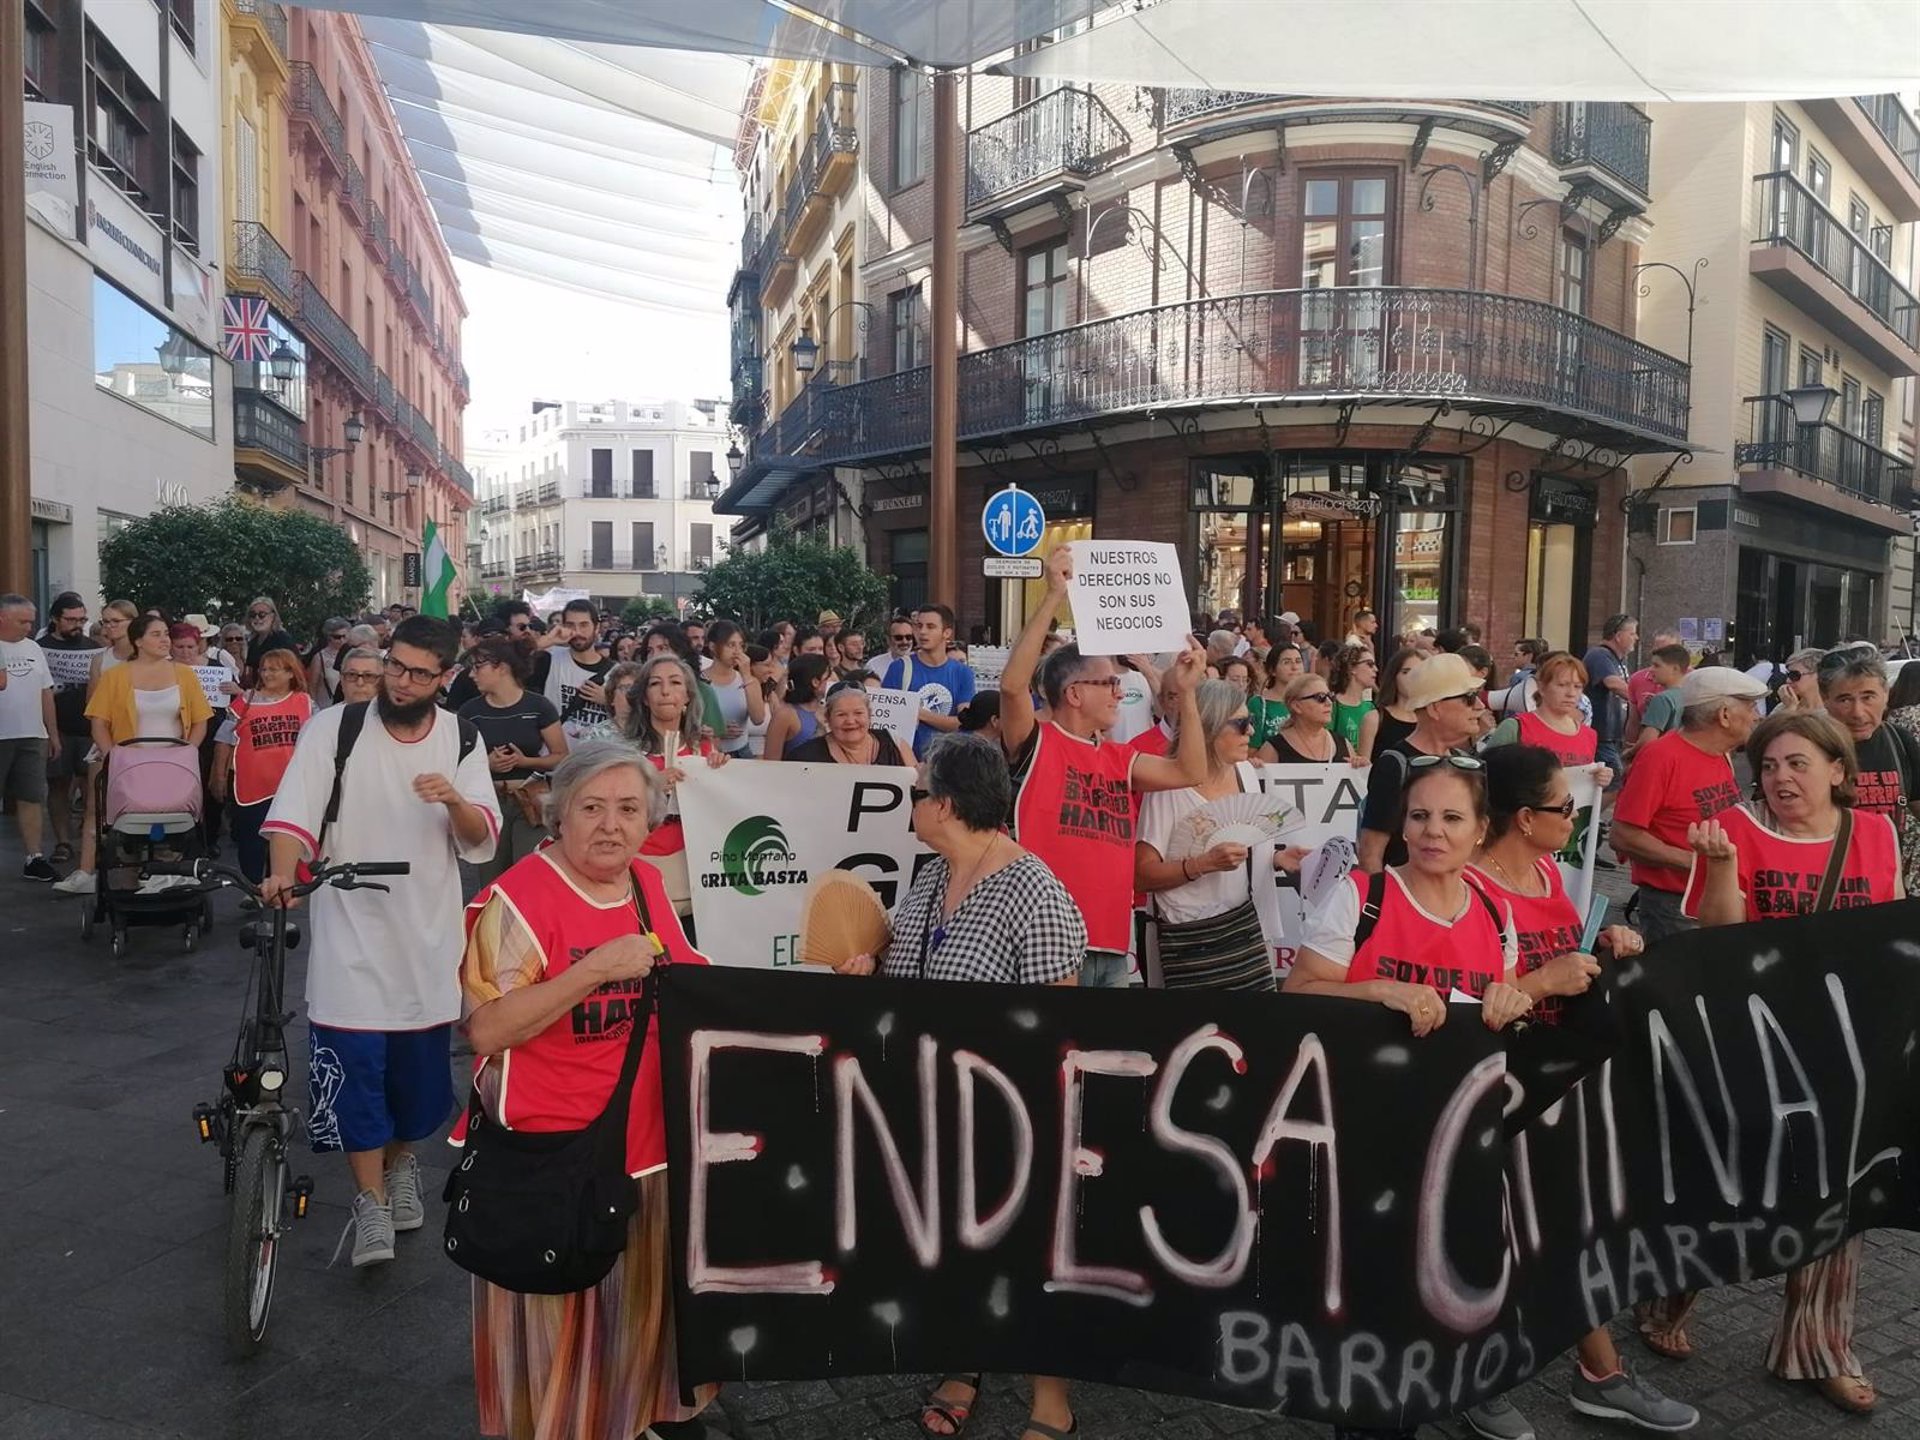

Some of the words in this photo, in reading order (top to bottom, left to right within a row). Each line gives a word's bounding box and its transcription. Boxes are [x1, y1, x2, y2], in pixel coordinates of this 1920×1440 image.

[25, 161, 57, 171] English
[24, 171, 66, 180] onnection
[1036, 489, 1071, 507] crazy
[1090, 551, 1158, 564] NUESTROS
[1079, 573, 1151, 586] DERECHOS
[1154, 572, 1172, 585] NO
[1099, 595, 1126, 608] SON
[1130, 594, 1156, 607] SUS
[1096, 615, 1163, 630] NEGOCIOS
[61, 652, 90, 660] DEFEN
[710, 851, 737, 863] Pino
[741, 850, 796, 863] Montano
[701, 871, 747, 889] GRITA
[752, 870, 808, 886] BASTA
[1755, 870, 1799, 889] SOY
[1376, 955, 1429, 985] SOY
[1433, 967, 1465, 989] DE
[1469, 970, 1496, 993] UN
[688, 1023, 1342, 1311] ENDESA
[1217, 1307, 1536, 1412] BARRIOS
[1579, 1202, 1850, 1329] HARTOS
